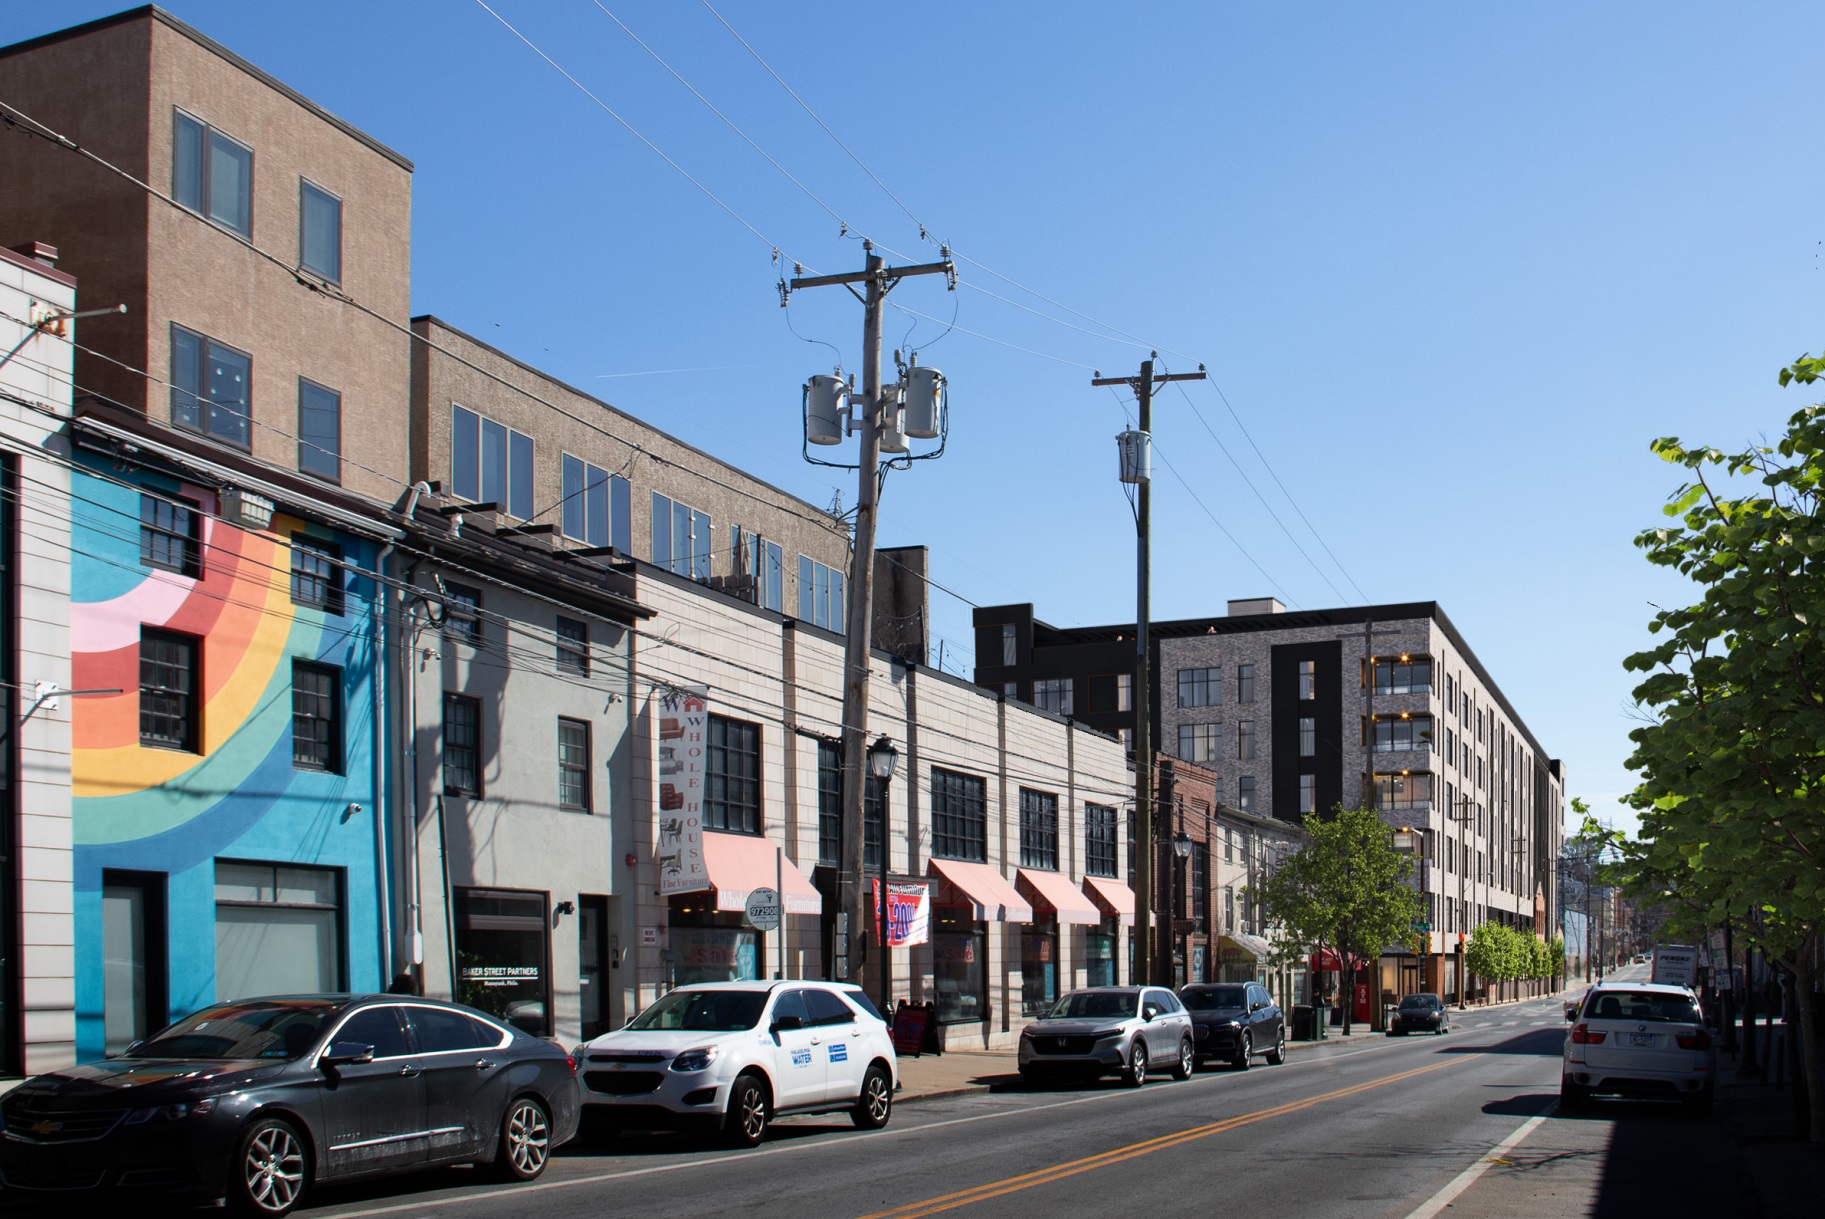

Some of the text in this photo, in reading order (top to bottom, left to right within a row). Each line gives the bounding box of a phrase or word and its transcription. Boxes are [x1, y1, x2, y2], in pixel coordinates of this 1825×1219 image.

[687, 717, 705, 873] WHOLE HOUSE
[663, 878, 708, 888] Fine Furniture
[720, 890, 820, 911] Whole Furniture
[462, 967, 538, 977] BAKER STREET PARTNERS
[792, 1053, 813, 1065] WATER
